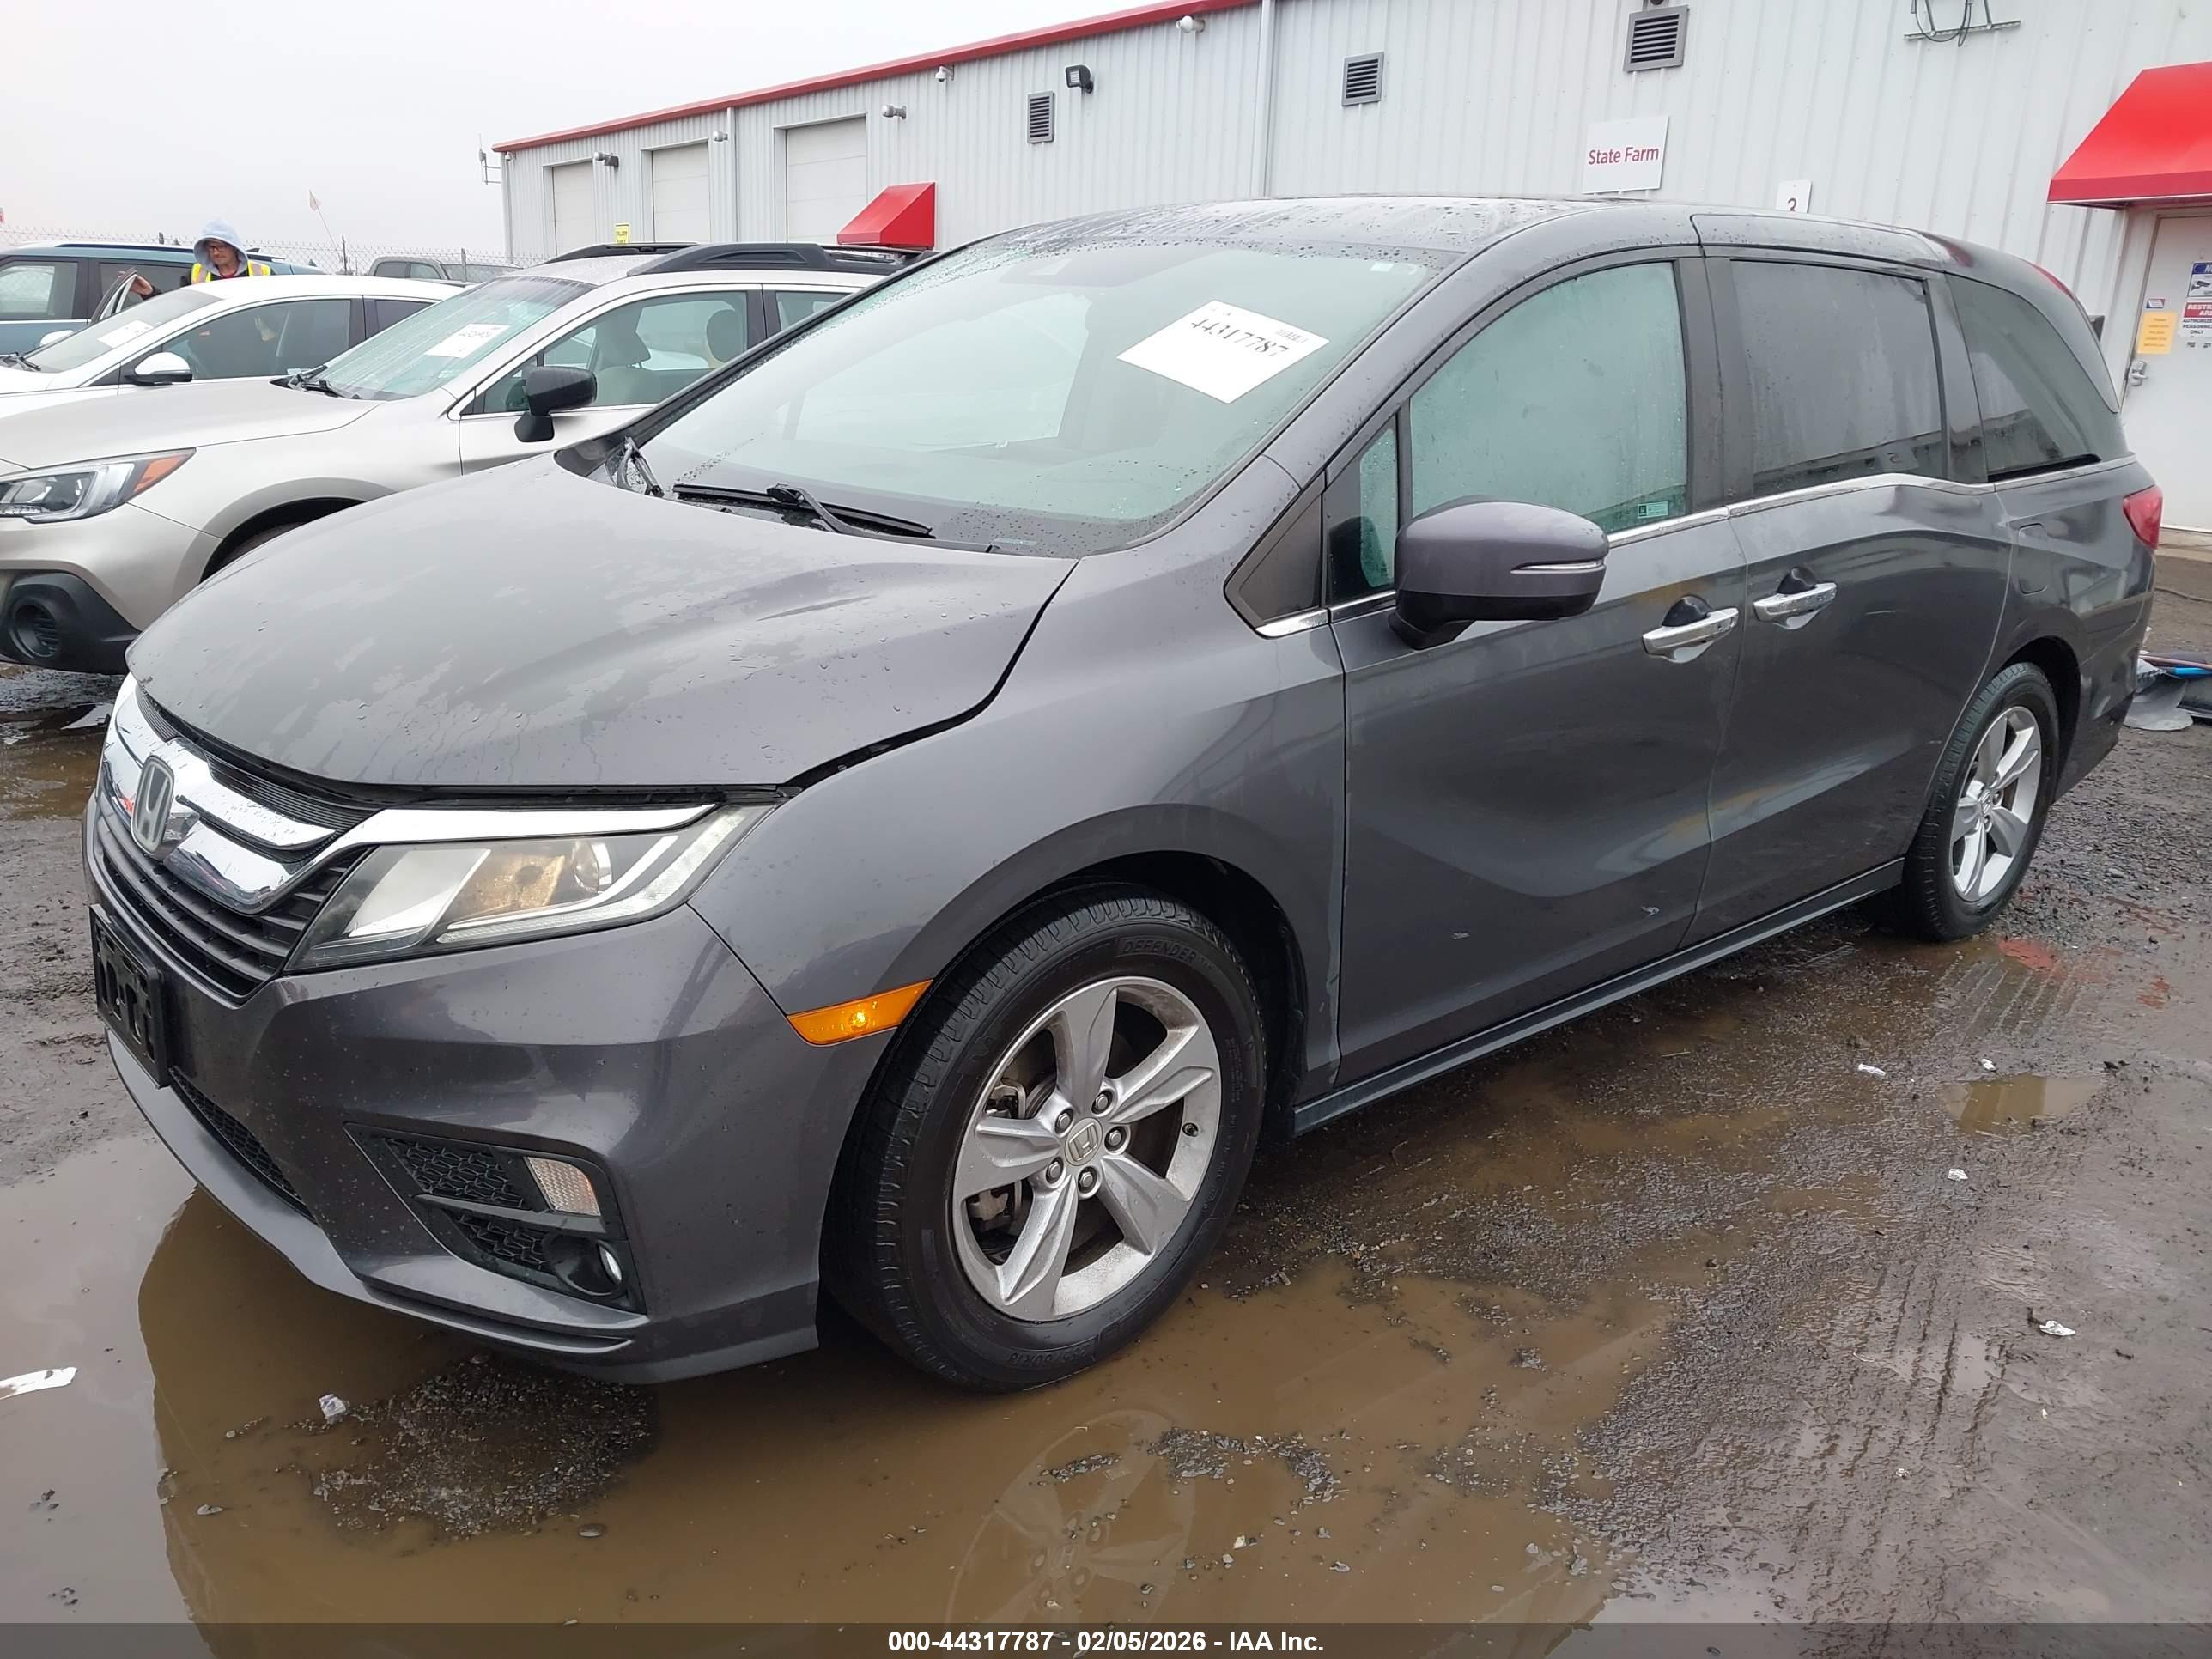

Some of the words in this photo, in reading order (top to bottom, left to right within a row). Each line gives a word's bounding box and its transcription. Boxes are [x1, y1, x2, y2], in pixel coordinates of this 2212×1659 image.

[1588, 148, 1622, 165] State
[1624, 146, 1660, 162] Farm
[1190, 318, 1290, 357] 44317787
[1119, 938, 1199, 963] DEFENDER
